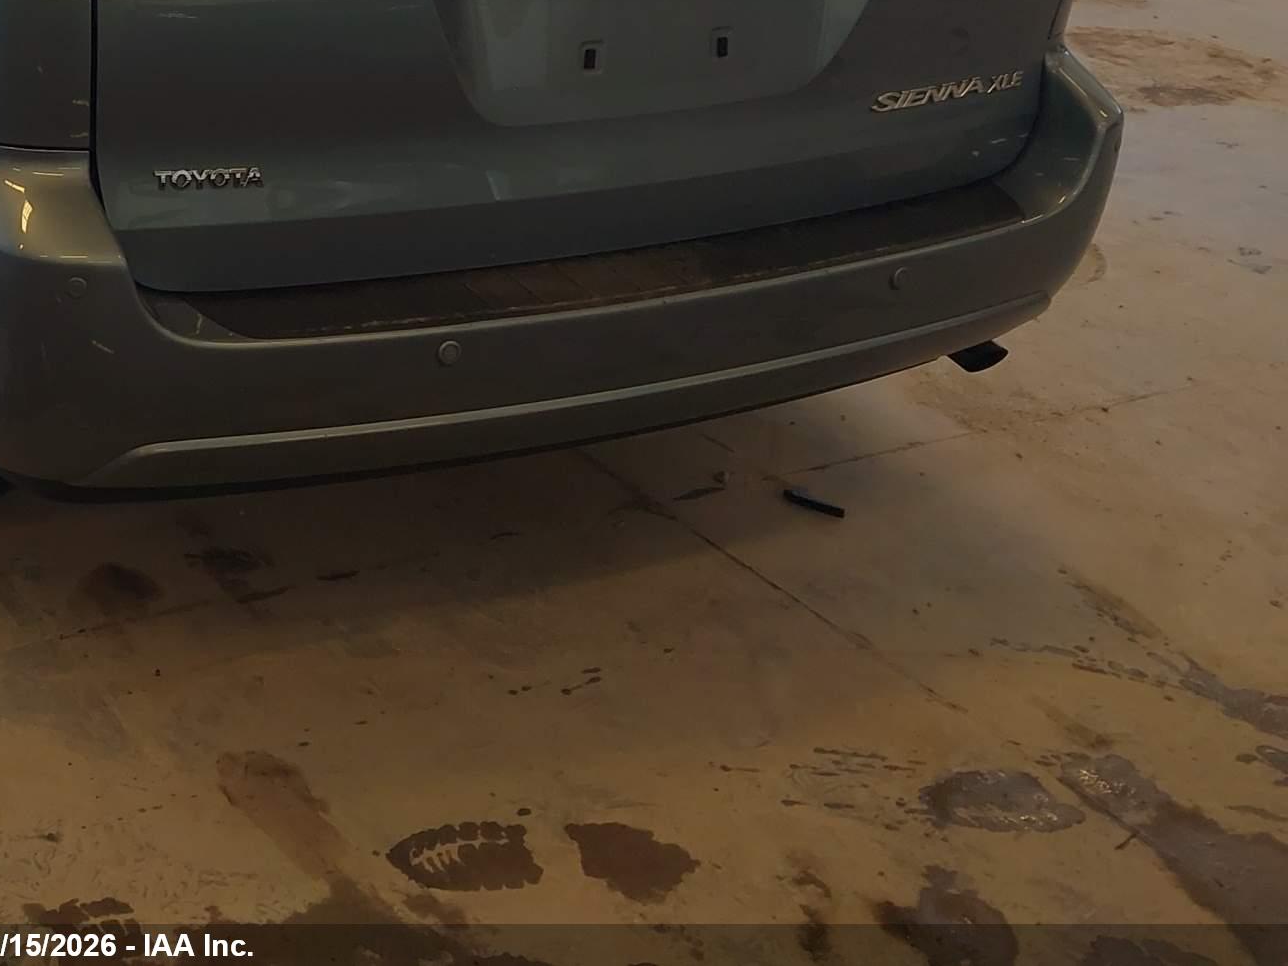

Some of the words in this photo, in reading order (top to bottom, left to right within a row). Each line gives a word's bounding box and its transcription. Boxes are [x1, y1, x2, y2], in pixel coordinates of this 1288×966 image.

[871, 76, 985, 112] SIENNA
[987, 70, 1025, 94] XLE
[153, 167, 264, 190] TOYOTA
